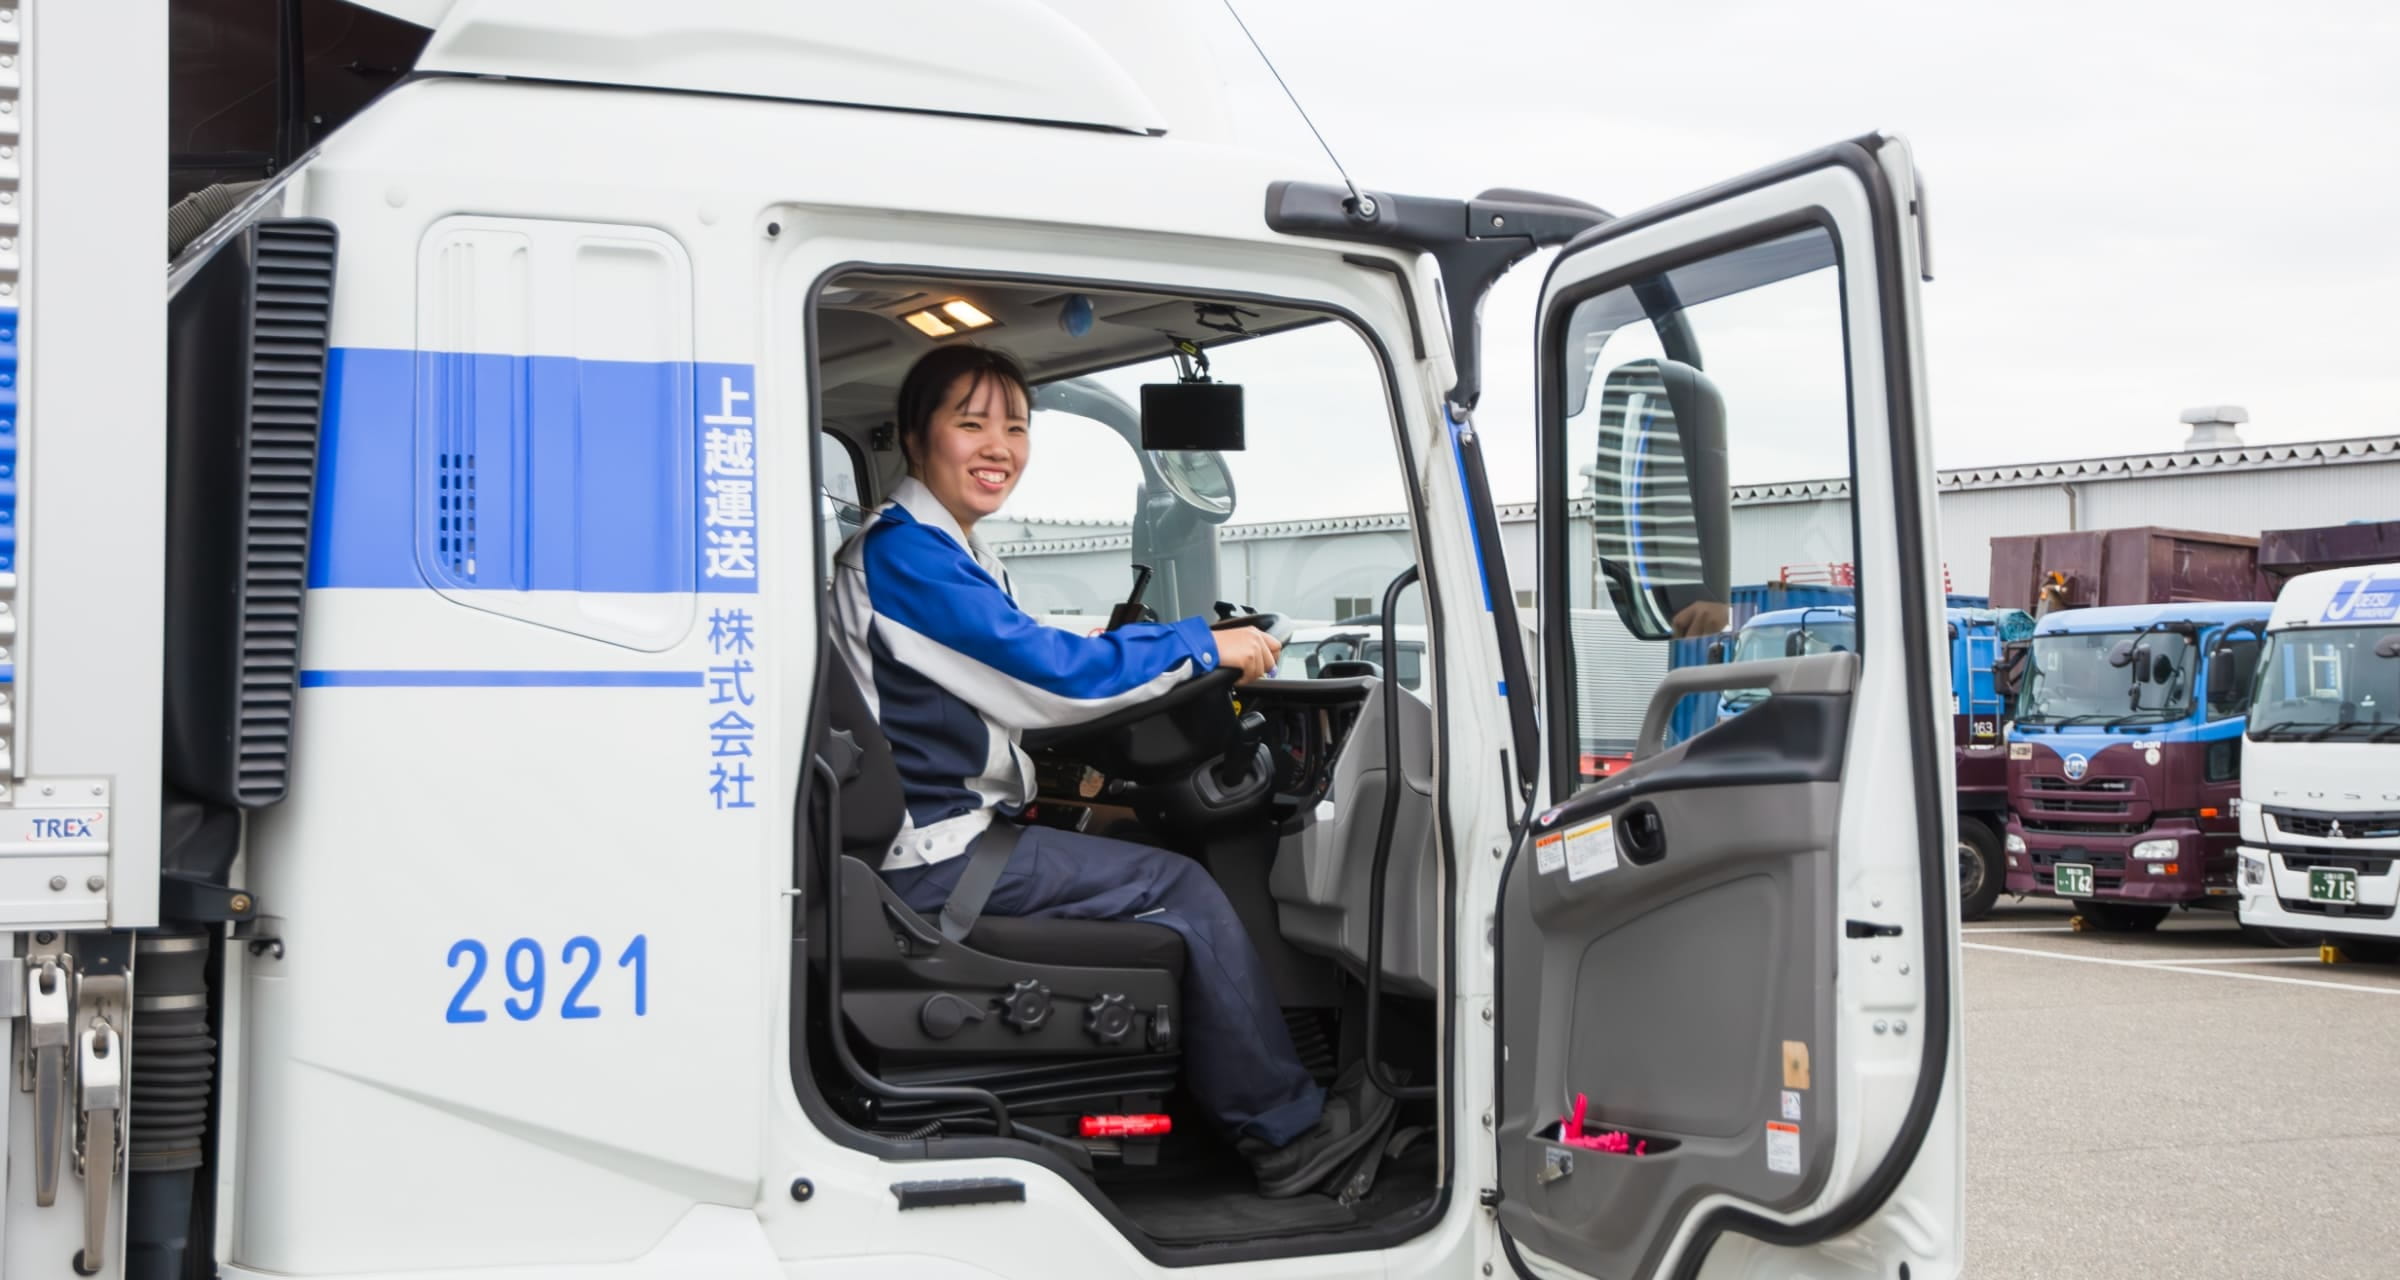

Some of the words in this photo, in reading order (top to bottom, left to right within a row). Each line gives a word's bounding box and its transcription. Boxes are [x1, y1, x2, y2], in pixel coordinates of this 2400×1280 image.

[703, 376, 756, 579] 上越運送
[708, 608, 756, 809] 株式会社
[1973, 721, 1993, 735] 163
[32, 818, 92, 838] TREX
[445, 933, 648, 1024] 2921
